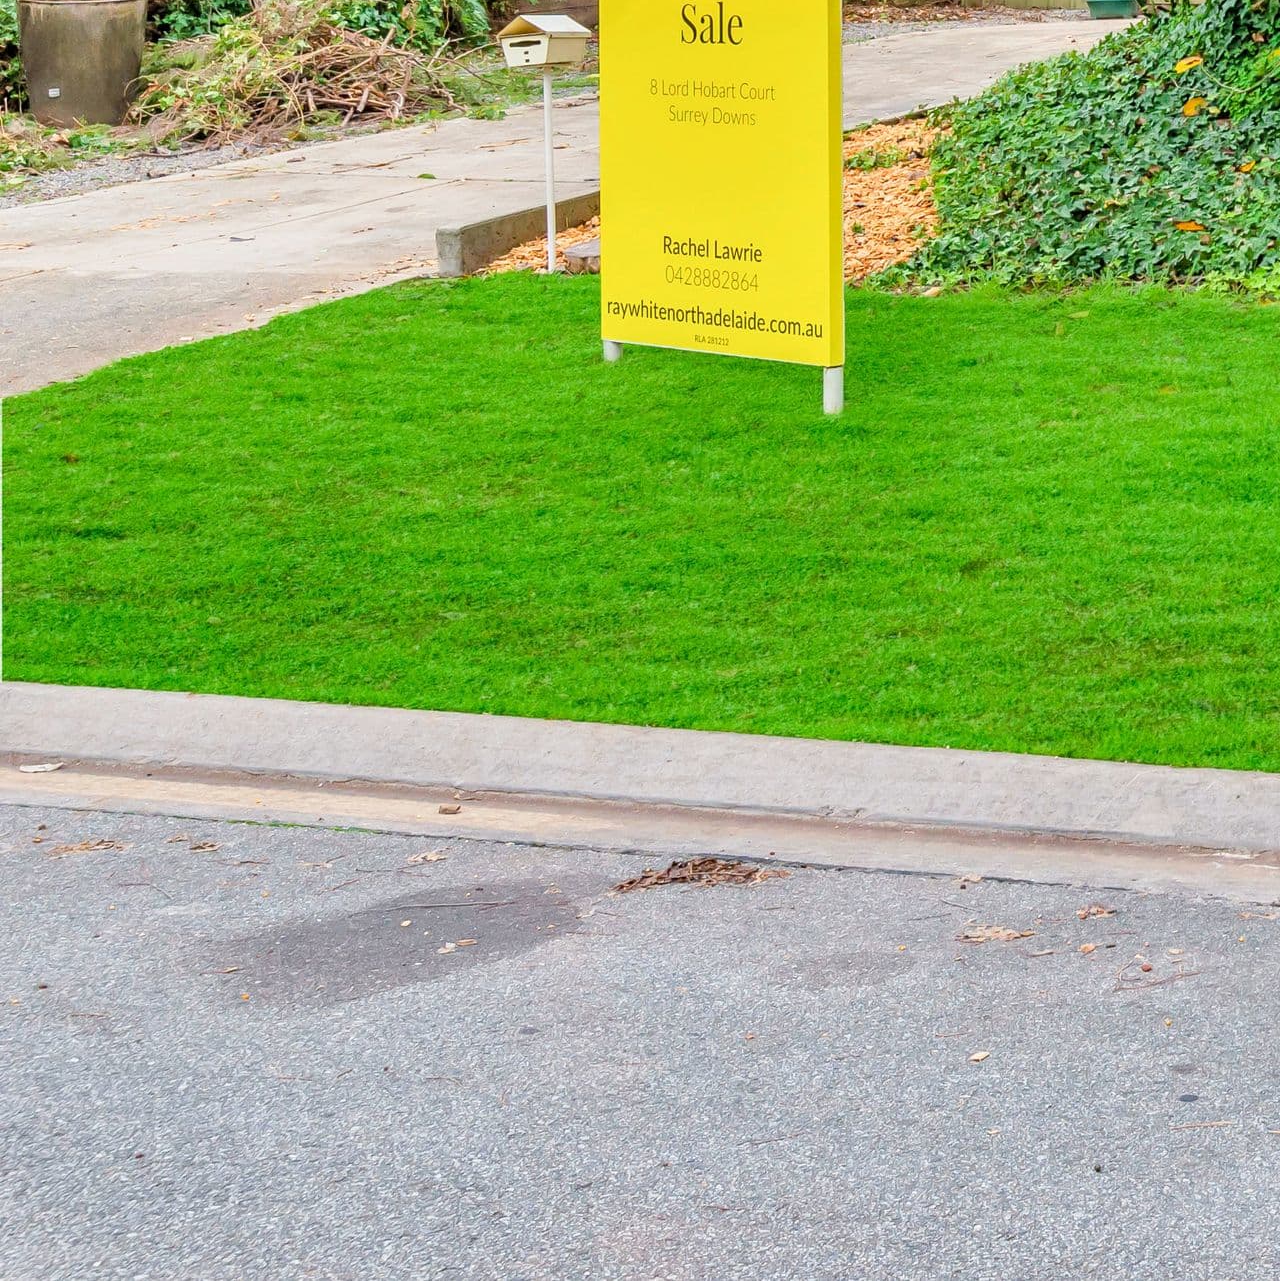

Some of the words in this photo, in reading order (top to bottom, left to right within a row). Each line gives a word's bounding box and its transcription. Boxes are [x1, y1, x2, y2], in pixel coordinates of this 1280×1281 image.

[680, 1, 744, 46] Sale
[650, 78, 658, 96] 8
[662, 79, 689, 97] Lord
[693, 80, 736, 99] Hobart
[739, 82, 776, 101] Court
[668, 104, 709, 126] Surrey
[712, 106, 757, 126] Downs
[663, 235, 709, 258] Rachel
[714, 239, 763, 263] Lawrie
[665, 264, 759, 292] 0428882864
[606, 299, 823, 339] raywhitenorthadelaide.com.au
[694, 334, 706, 344] RLA
